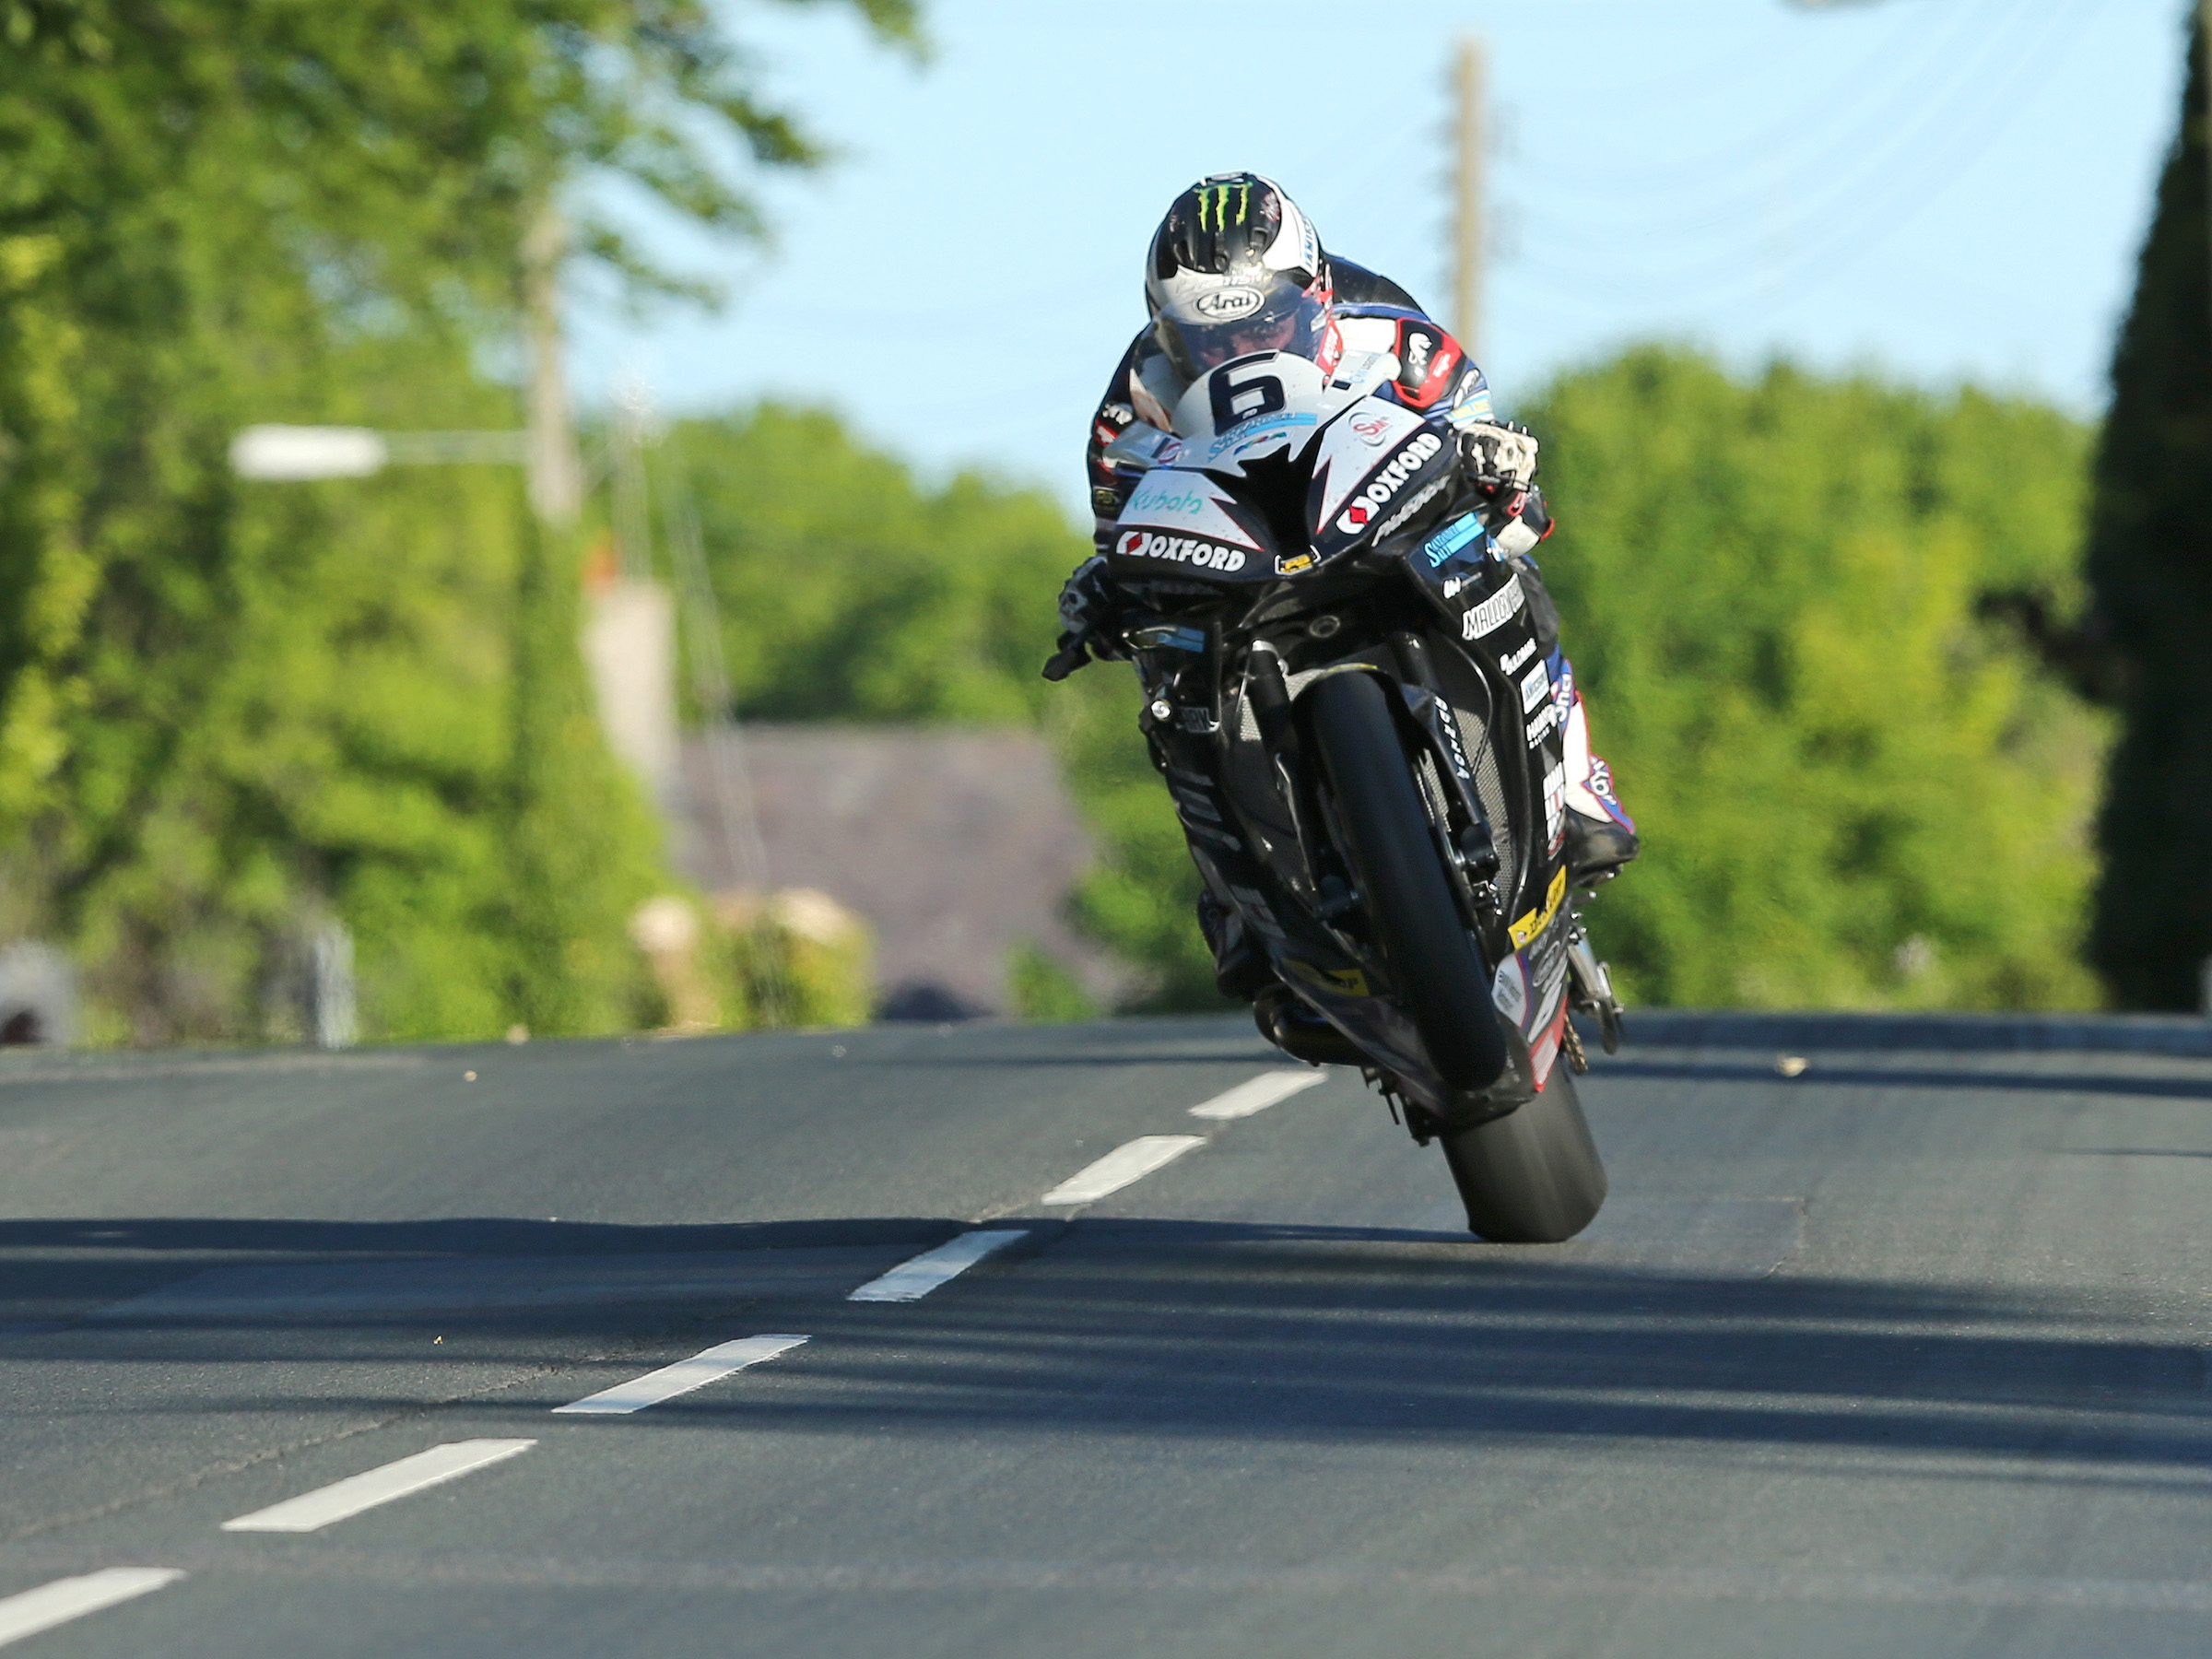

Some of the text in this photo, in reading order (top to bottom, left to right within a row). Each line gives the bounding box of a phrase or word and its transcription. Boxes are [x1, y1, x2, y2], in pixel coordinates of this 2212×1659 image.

[1201, 293, 1253, 312] Arai
[1208, 351, 1285, 436] 6
[1366, 432, 1442, 503] OXFORD
[1130, 489, 1203, 514] Kubota
[1148, 535, 1246, 572] OXFORD
